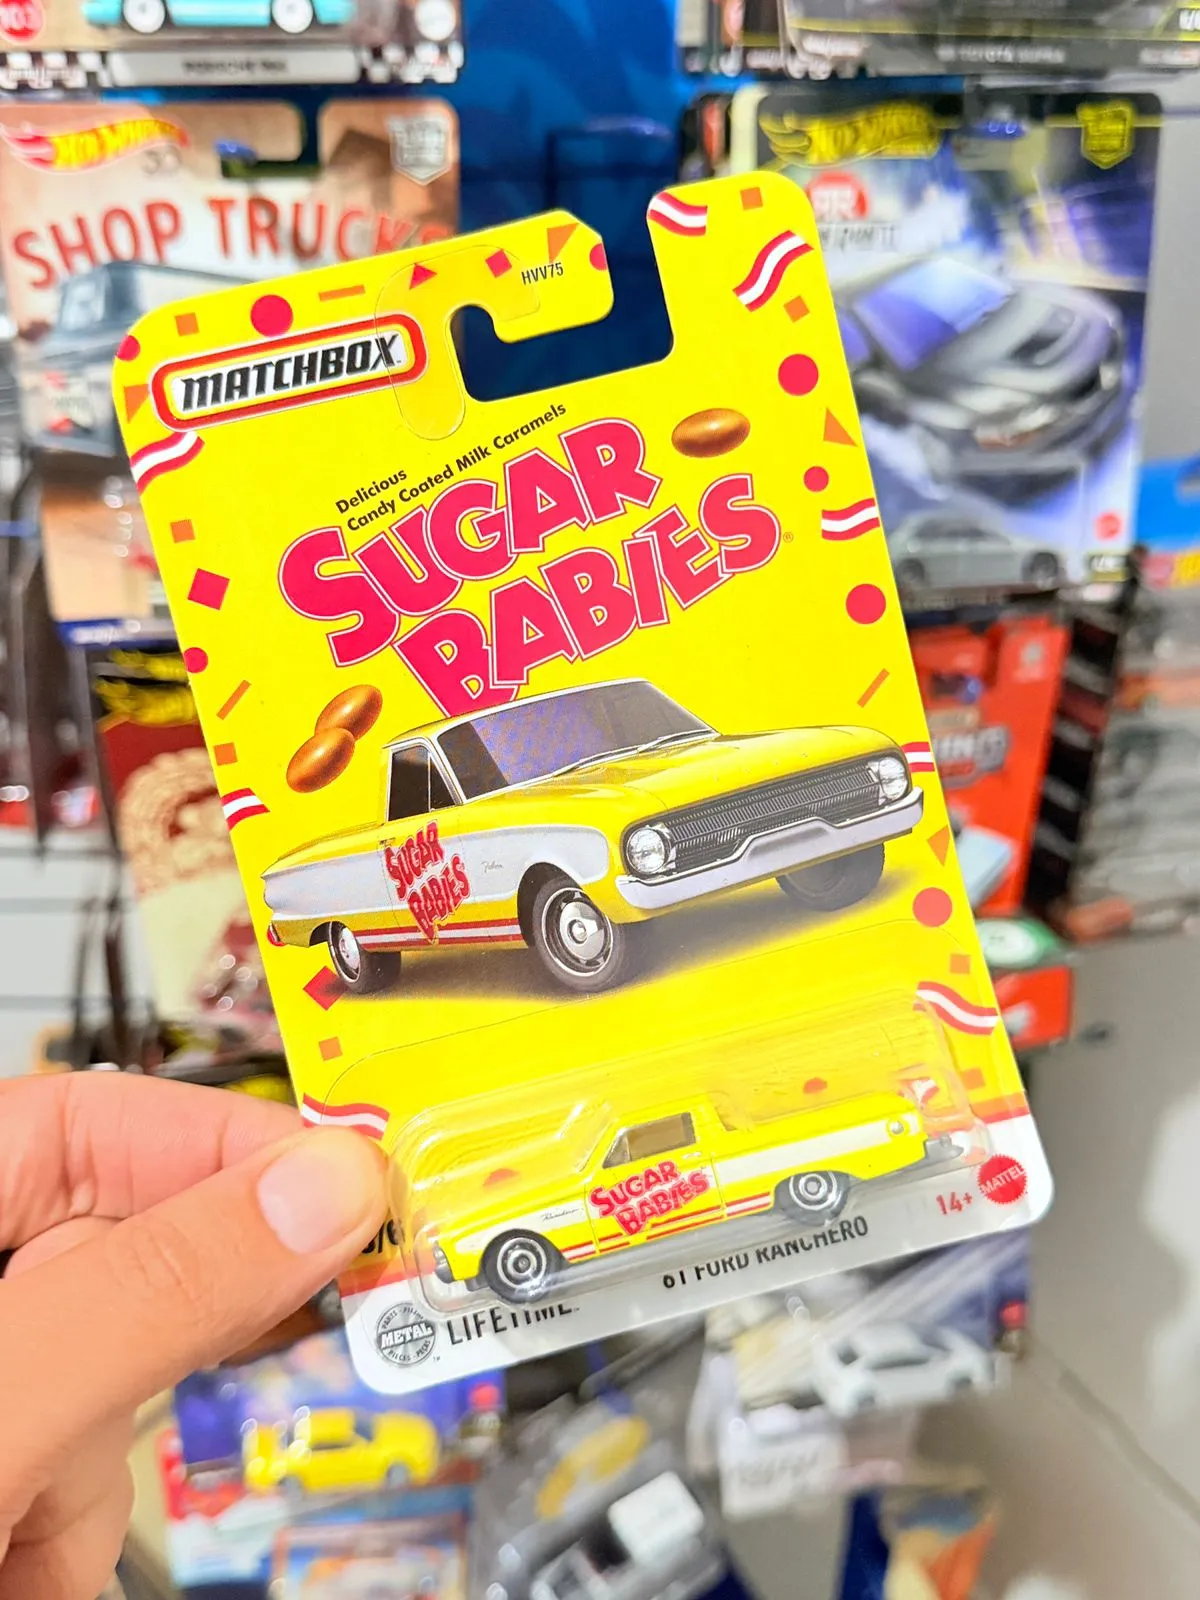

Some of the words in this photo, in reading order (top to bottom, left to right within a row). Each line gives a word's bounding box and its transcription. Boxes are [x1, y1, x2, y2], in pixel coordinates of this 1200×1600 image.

[13, 200, 181, 290] SHOP
[521, 262, 564, 286] HVV75
[180, 333, 400, 412] MATCHBOX
[335, 468, 408, 514] Delicious
[347, 498, 396, 532] Candy
[398, 465, 455, 503] Coated
[455, 445, 492, 473] Milk
[493, 402, 567, 450] Caramels
[277, 417, 663, 667] SUGAR
[392, 473, 781, 719] BABIES
[384, 820, 446, 900] SUGAR
[407, 853, 473, 945] BABIES
[589, 1160, 682, 1219] SUGAR
[614, 1171, 710, 1236] BABIES
[936, 1191, 973, 1215] 14+
[980, 1164, 1025, 1195] MATTEL
[695, 1252, 750, 1281] FORD
[756, 1215, 869, 1264] RANCHERO
[381, 1321, 434, 1349] METAL
